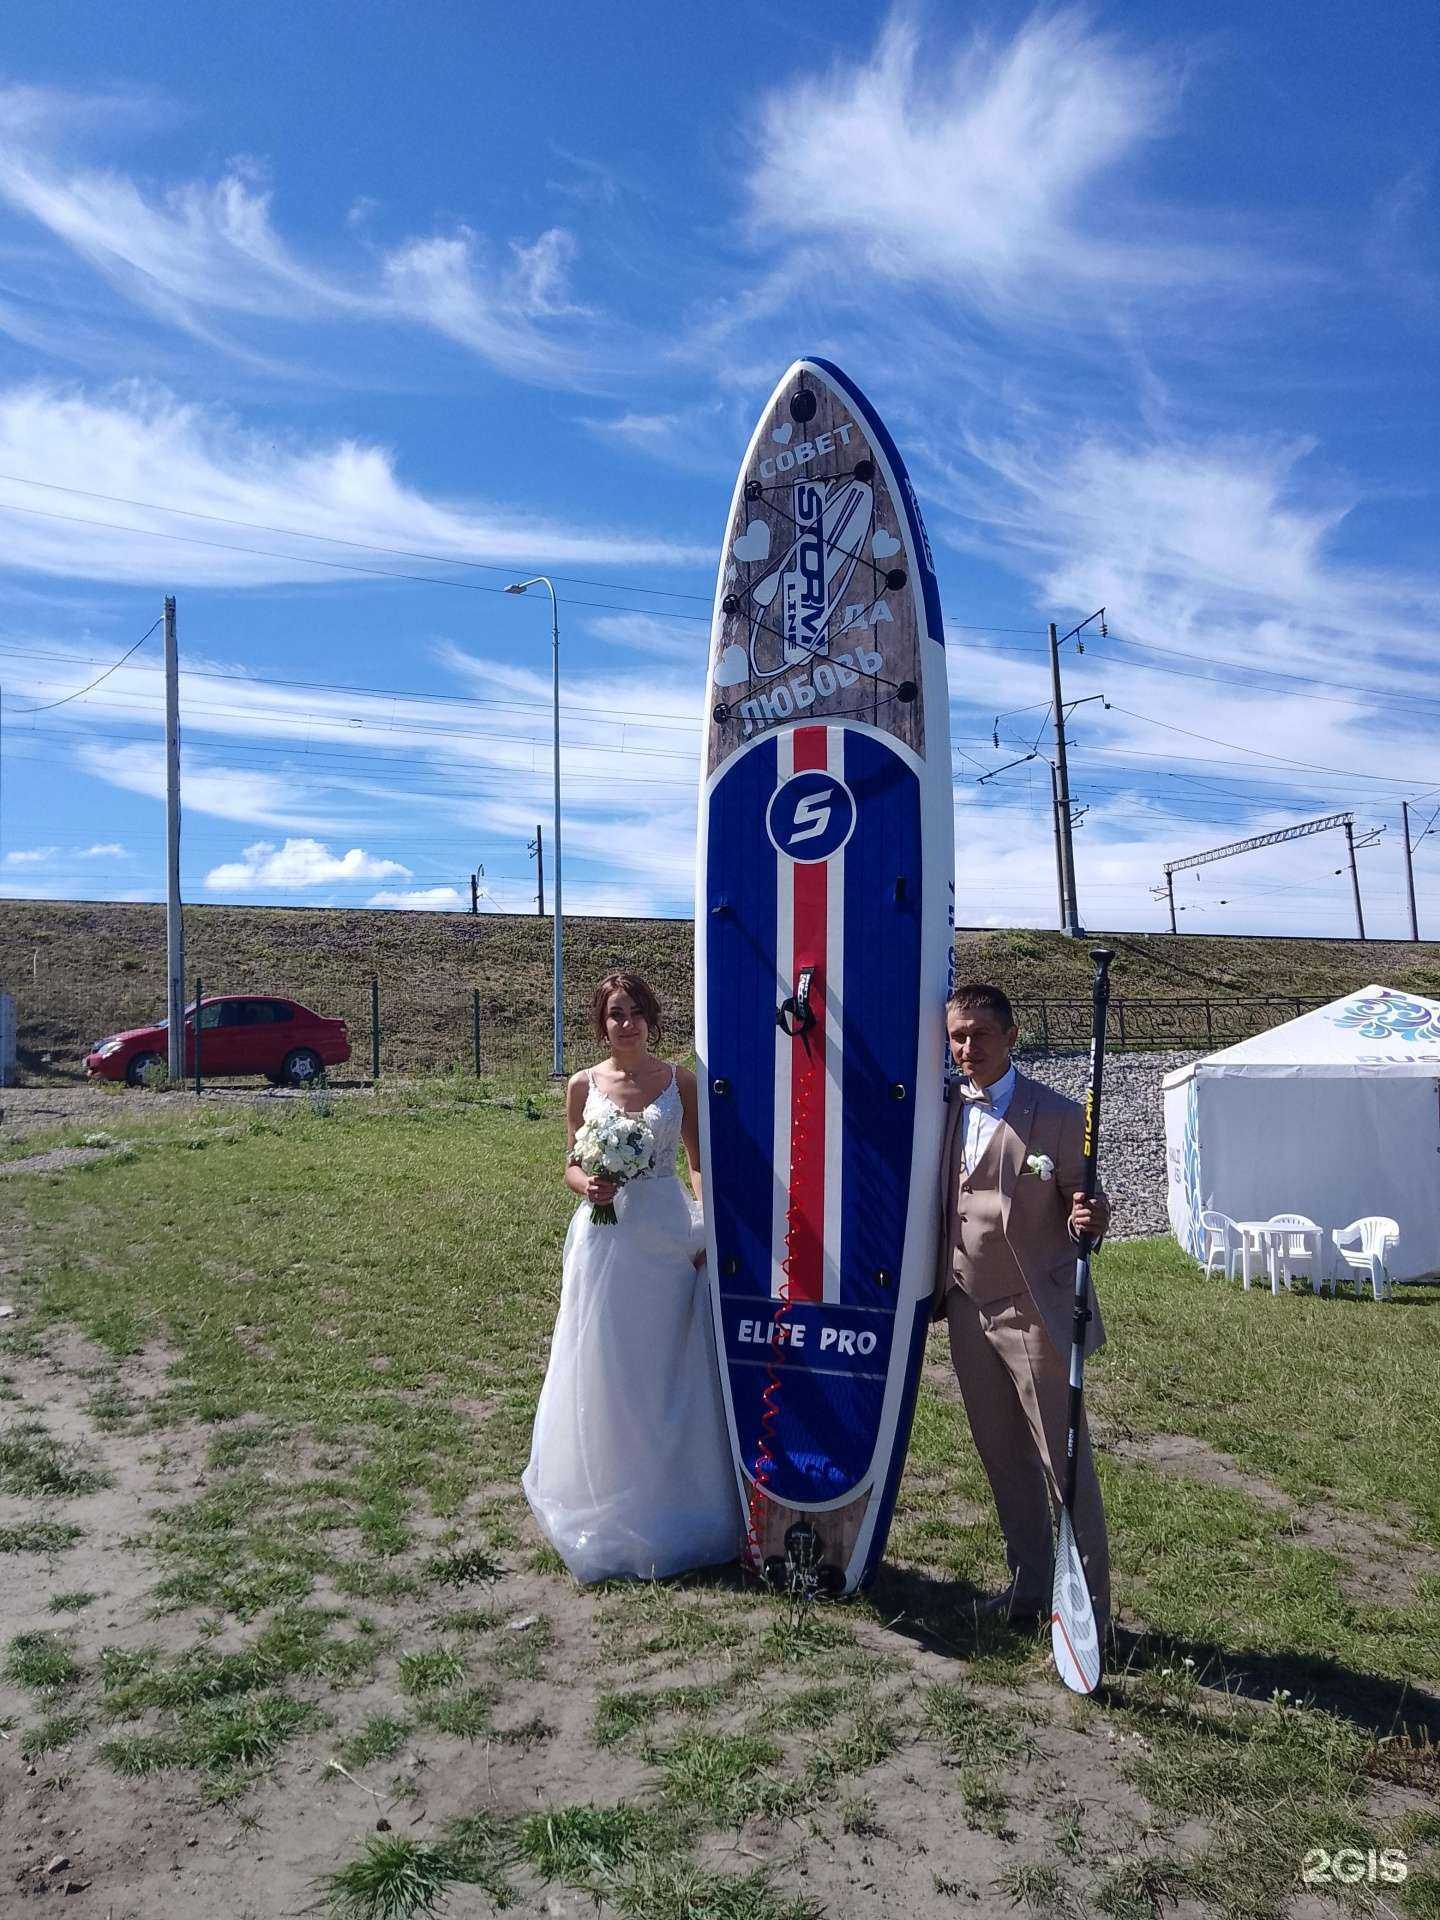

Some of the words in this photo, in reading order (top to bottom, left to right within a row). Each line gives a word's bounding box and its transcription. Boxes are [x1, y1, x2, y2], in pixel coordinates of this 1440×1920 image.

[759, 422, 854, 479] СОВЕТ
[799, 485, 828, 650] STORM
[787, 583, 797, 650] LINE
[840, 600, 894, 634] ДА
[739, 646, 883, 736] ЛЮБОВЬ
[738, 1319, 806, 1348] ELITE
[819, 1327, 877, 1356] PRO
